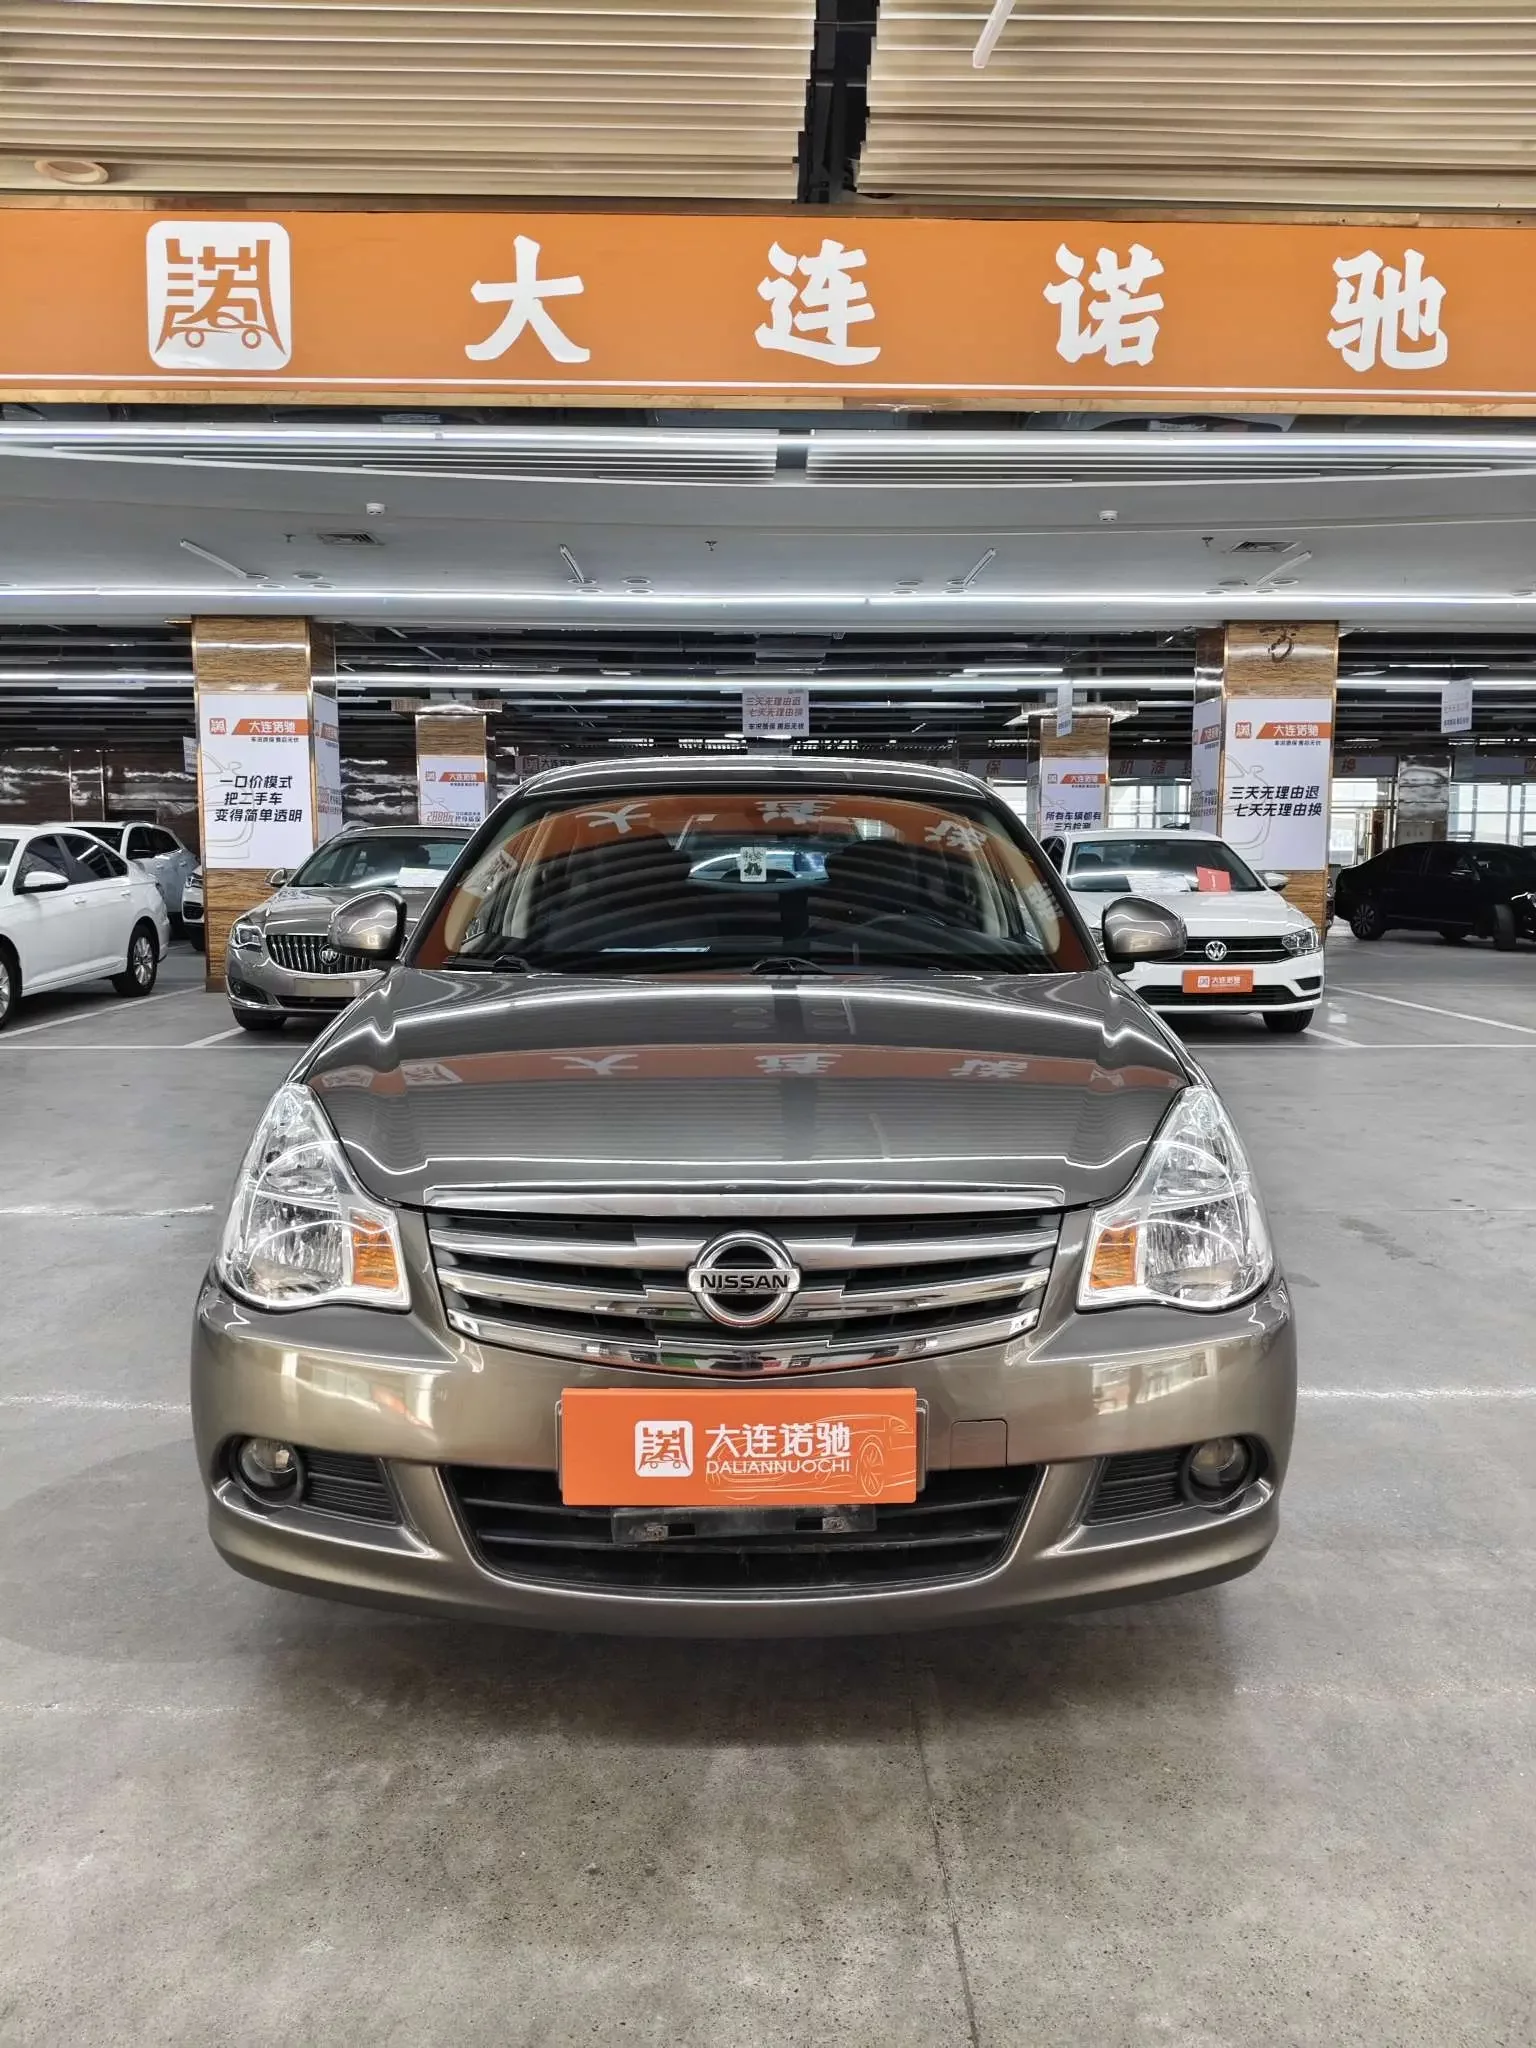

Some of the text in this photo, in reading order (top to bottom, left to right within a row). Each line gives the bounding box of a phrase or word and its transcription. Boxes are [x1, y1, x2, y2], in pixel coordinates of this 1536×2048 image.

[464, 233, 1449, 372] 大连诺驰
[248, 721, 296, 734] 大连诺驰
[1273, 724, 1319, 737] 大连诺驰
[219, 775, 293, 789] 一口价模式
[224, 791, 284, 806] 把二手车
[1230, 785, 1320, 800] 三天无理由退
[214, 808, 303, 823] 变得简单透明
[1046, 811, 1102, 821] 所有车辆都有
[1234, 803, 1322, 817] 七天无理由换
[1053, 822, 1091, 832] 三方检测
[700, 1274, 789, 1289] NISSAN
[705, 1422, 851, 1459] 大连诺驰
[705, 1460, 851, 1474] DALIANNUOCHI
